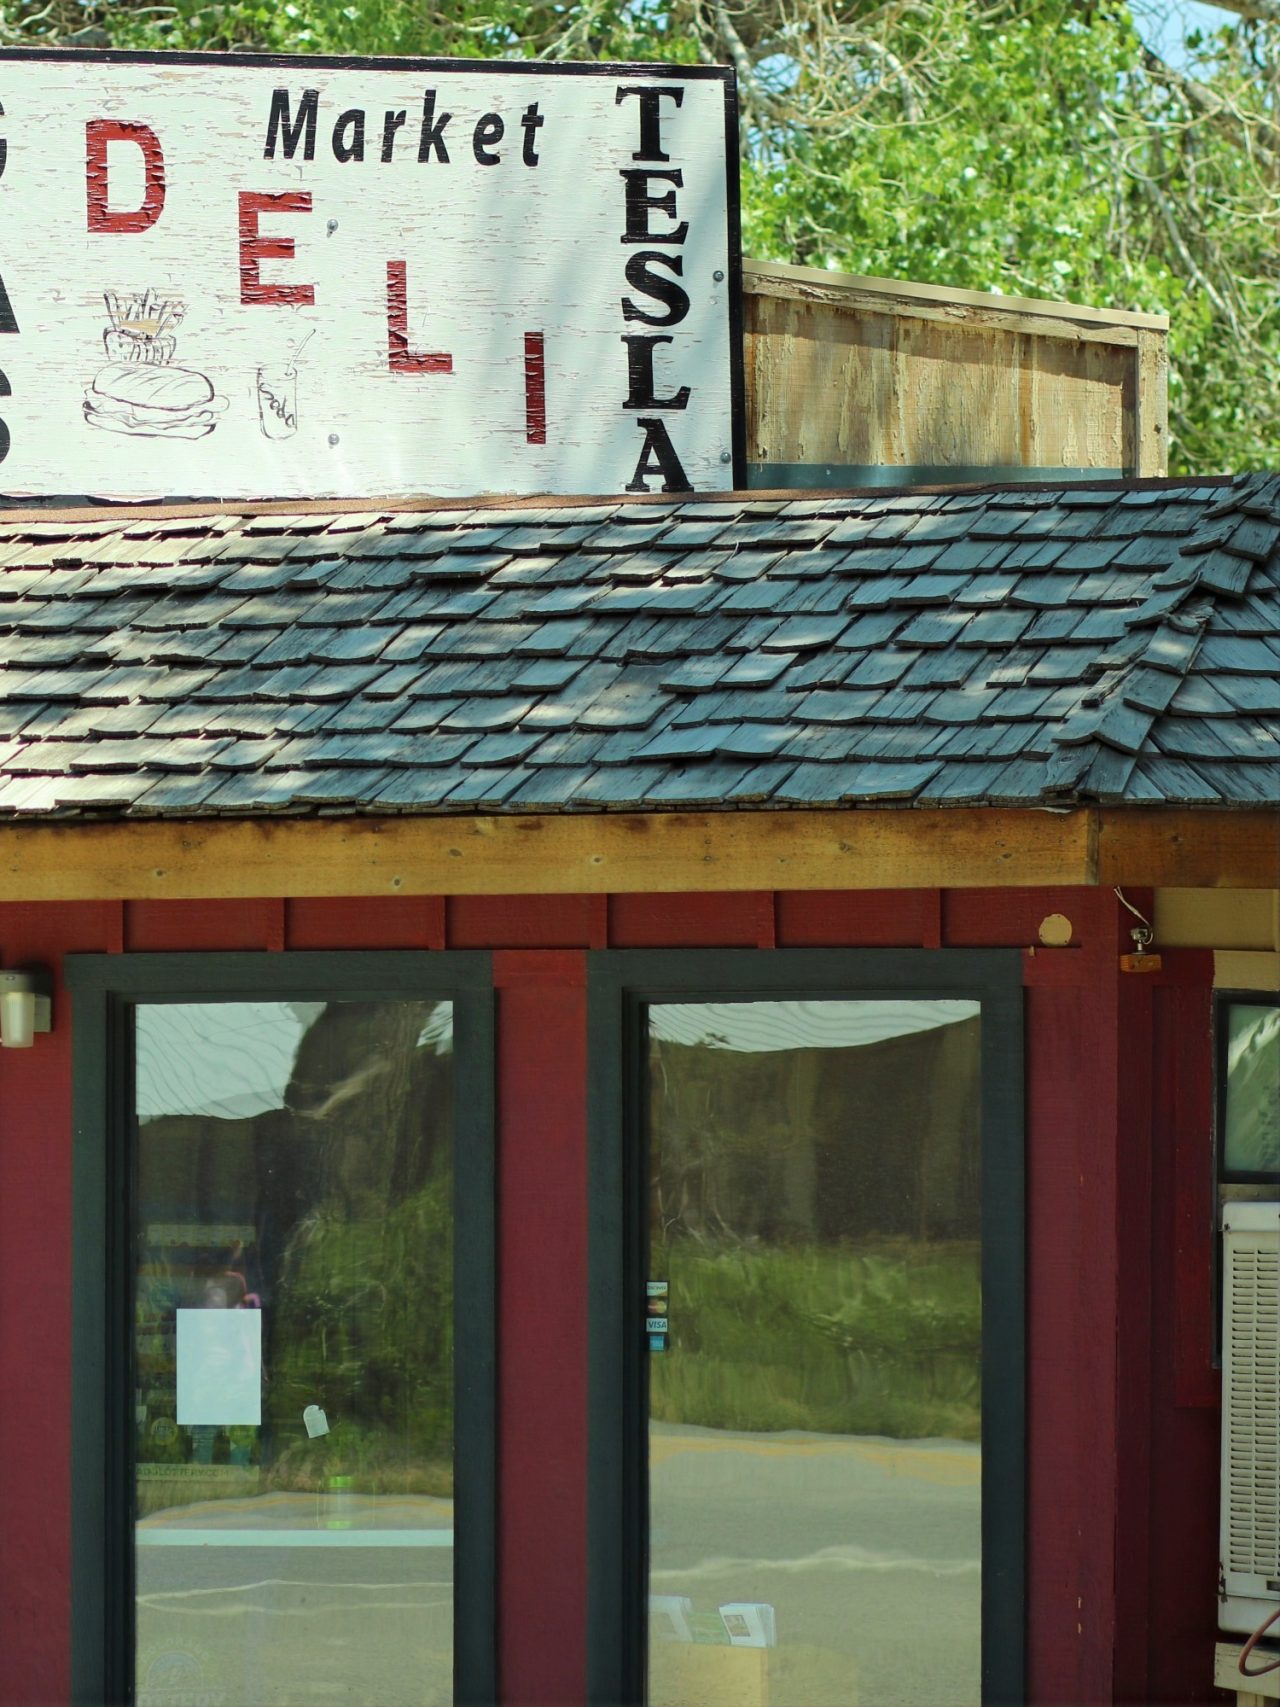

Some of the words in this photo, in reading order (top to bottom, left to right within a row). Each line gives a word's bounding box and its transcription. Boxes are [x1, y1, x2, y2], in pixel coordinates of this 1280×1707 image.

[263, 88, 544, 167] Market
[85, 118, 545, 445] DELI
[616, 86, 695, 492] TESLA
[648, 1321, 667, 1329] VISA
